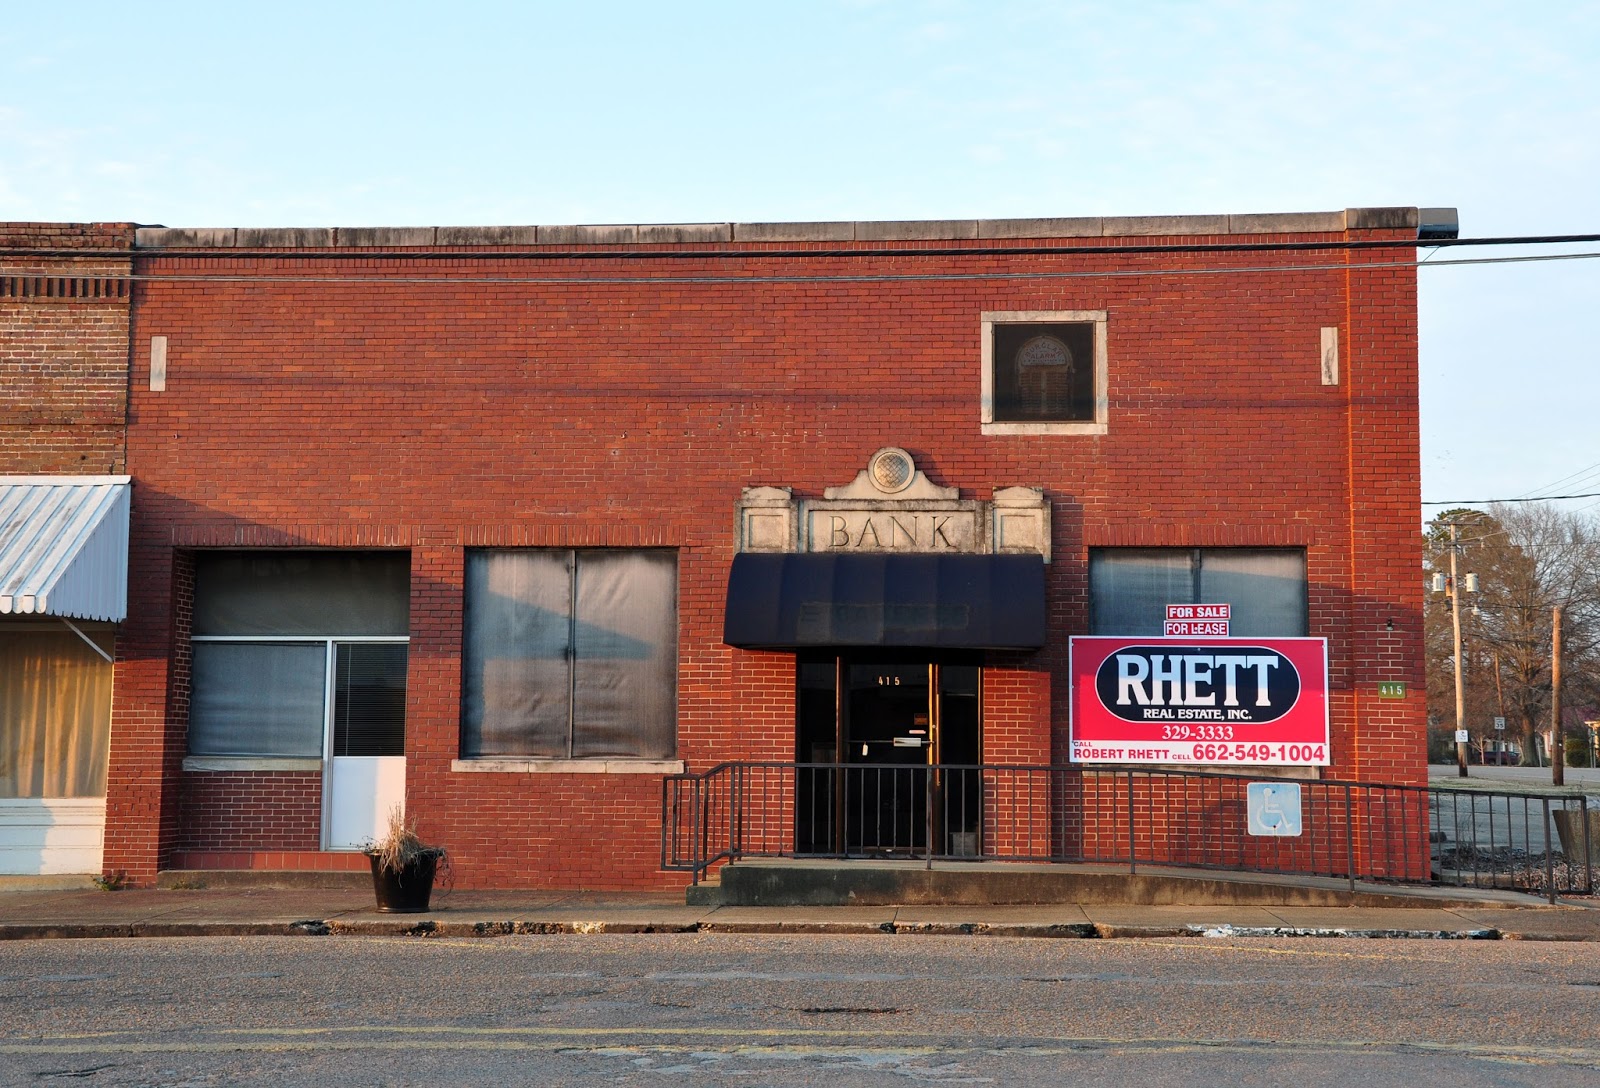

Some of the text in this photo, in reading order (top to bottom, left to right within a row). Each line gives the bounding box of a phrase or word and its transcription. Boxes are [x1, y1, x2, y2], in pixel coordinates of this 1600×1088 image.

[1024, 341, 1064, 357] BURGLAR
[828, 515, 957, 548] BANK
[1169, 607, 1228, 618] FOR SALE
[1166, 623, 1227, 635] FOR LEASE
[878, 676, 900, 686] 415
[1116, 654, 1279, 707] RHETT
[1381, 685, 1403, 695] 415
[1143, 708, 1253, 721] REAL ESTATE, INC.
[1162, 725, 1234, 740] 329-3333
[1074, 749, 1124, 759] ROBERT
[1128, 749, 1170, 760] RHETT
[1192, 743, 1325, 762] 662-549-1004
